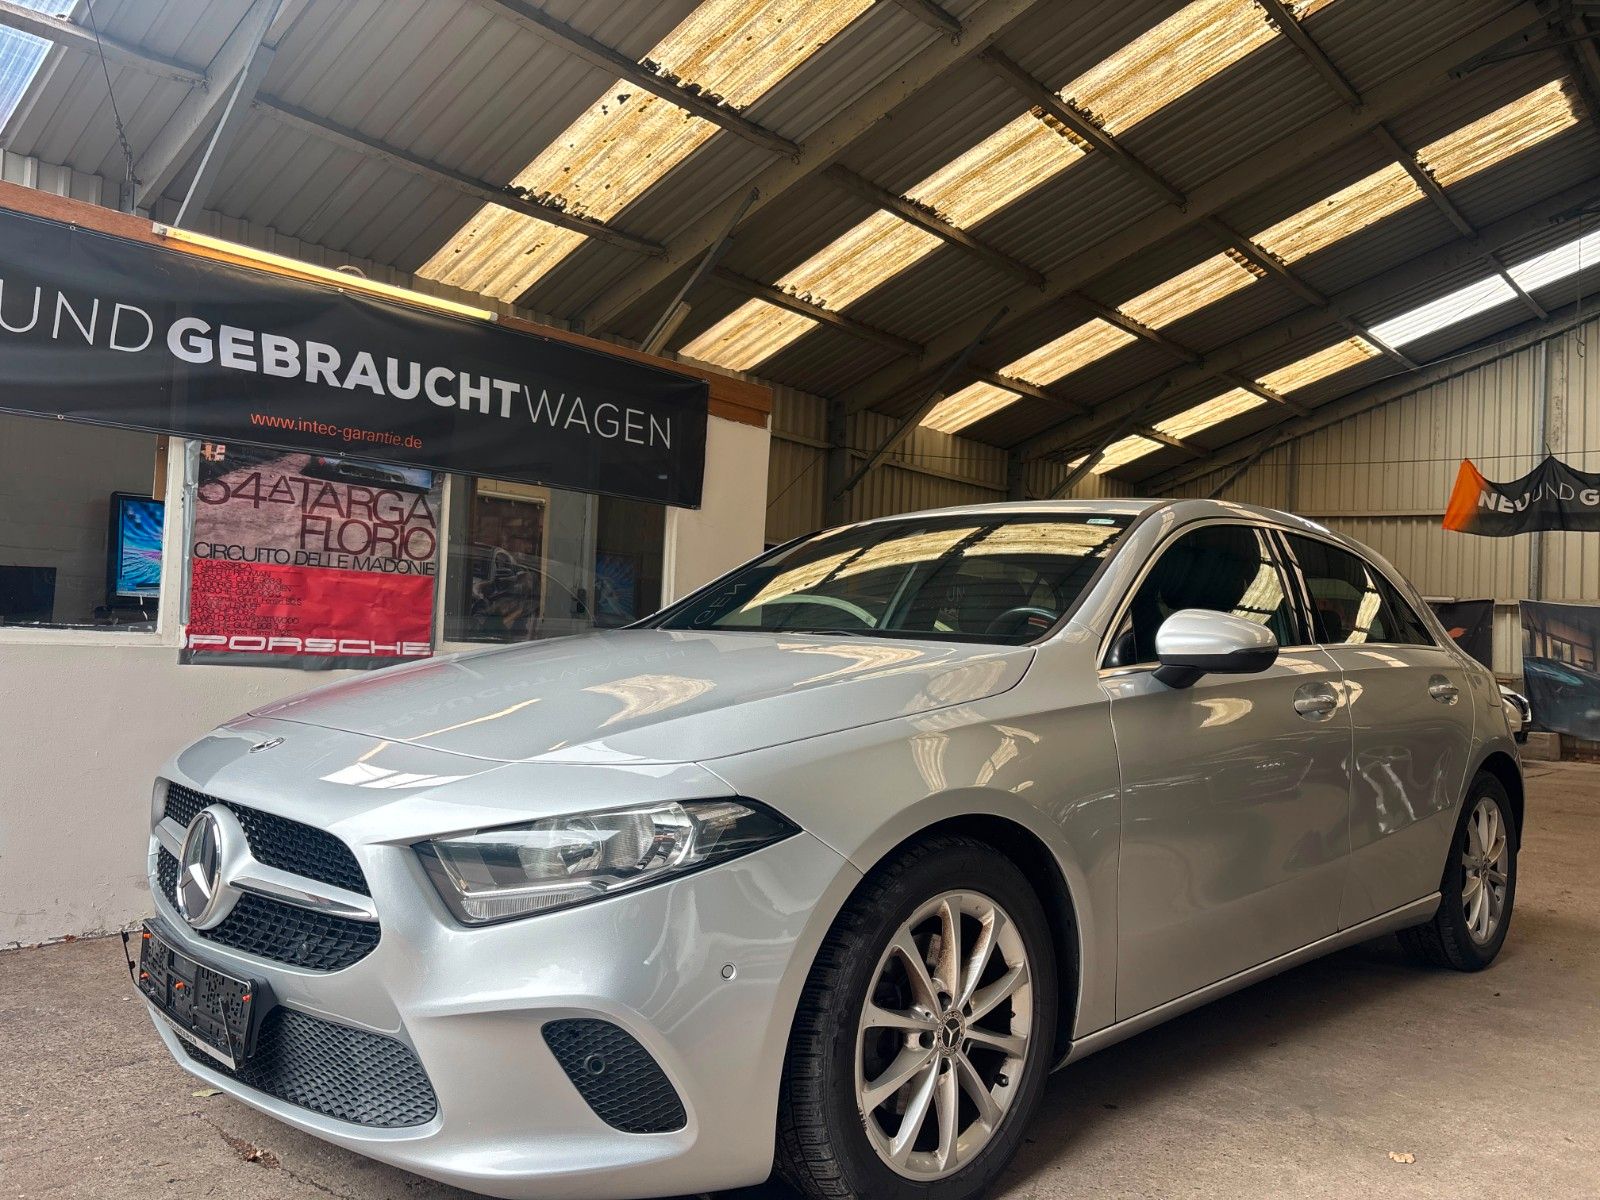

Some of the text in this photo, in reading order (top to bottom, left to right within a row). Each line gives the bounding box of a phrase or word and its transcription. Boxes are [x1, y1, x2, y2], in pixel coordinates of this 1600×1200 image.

[0, 279, 672, 449] UND GEBRAUCHTWAGEN
[250, 412, 423, 449] www.intec-garantie.de
[289, 477, 437, 529] TARGA
[1477, 489, 1530, 514] NEU
[1531, 482, 1575, 503] UND
[300, 515, 437, 561] FLORIO
[193, 541, 436, 574] CIRCUITO DELLE MADONIE
[188, 634, 431, 656] PORSCHE
